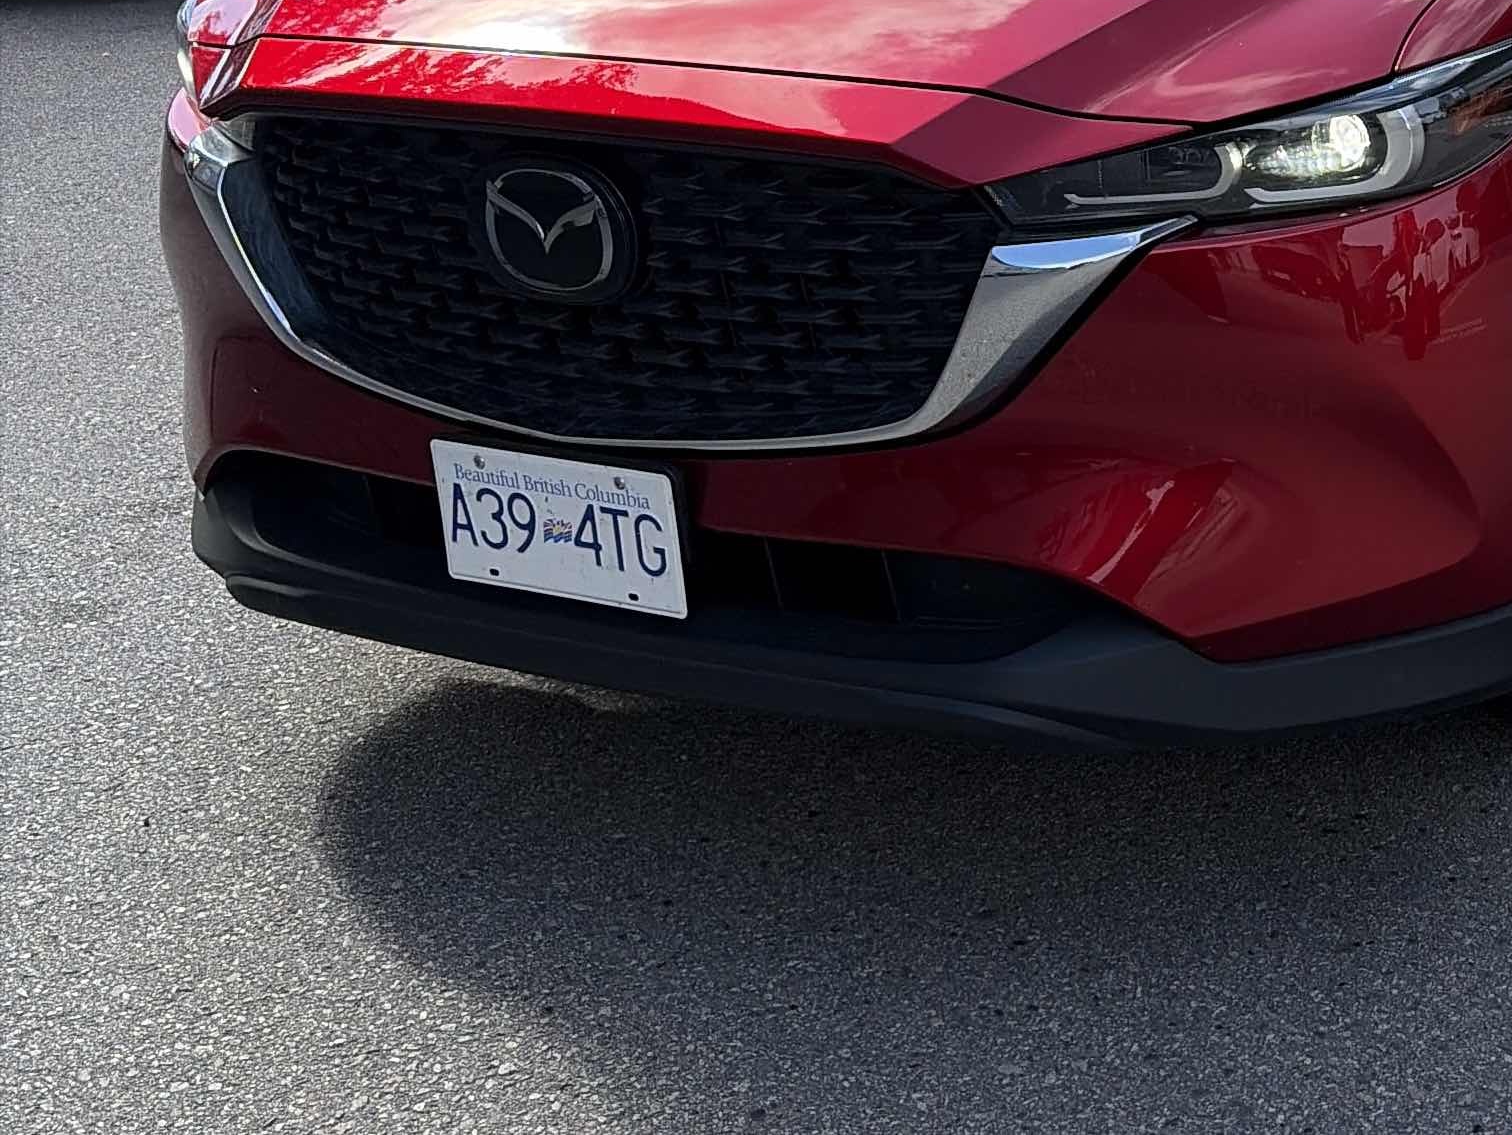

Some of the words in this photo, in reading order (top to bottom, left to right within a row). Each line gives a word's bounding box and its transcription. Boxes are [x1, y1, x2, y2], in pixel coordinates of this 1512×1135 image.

[453, 463, 520, 489] Beautiful
[522, 474, 572, 498] British
[574, 483, 650, 510] Columbia
[452, 482, 537, 553] A39
[574, 504, 667, 577] 4TG
